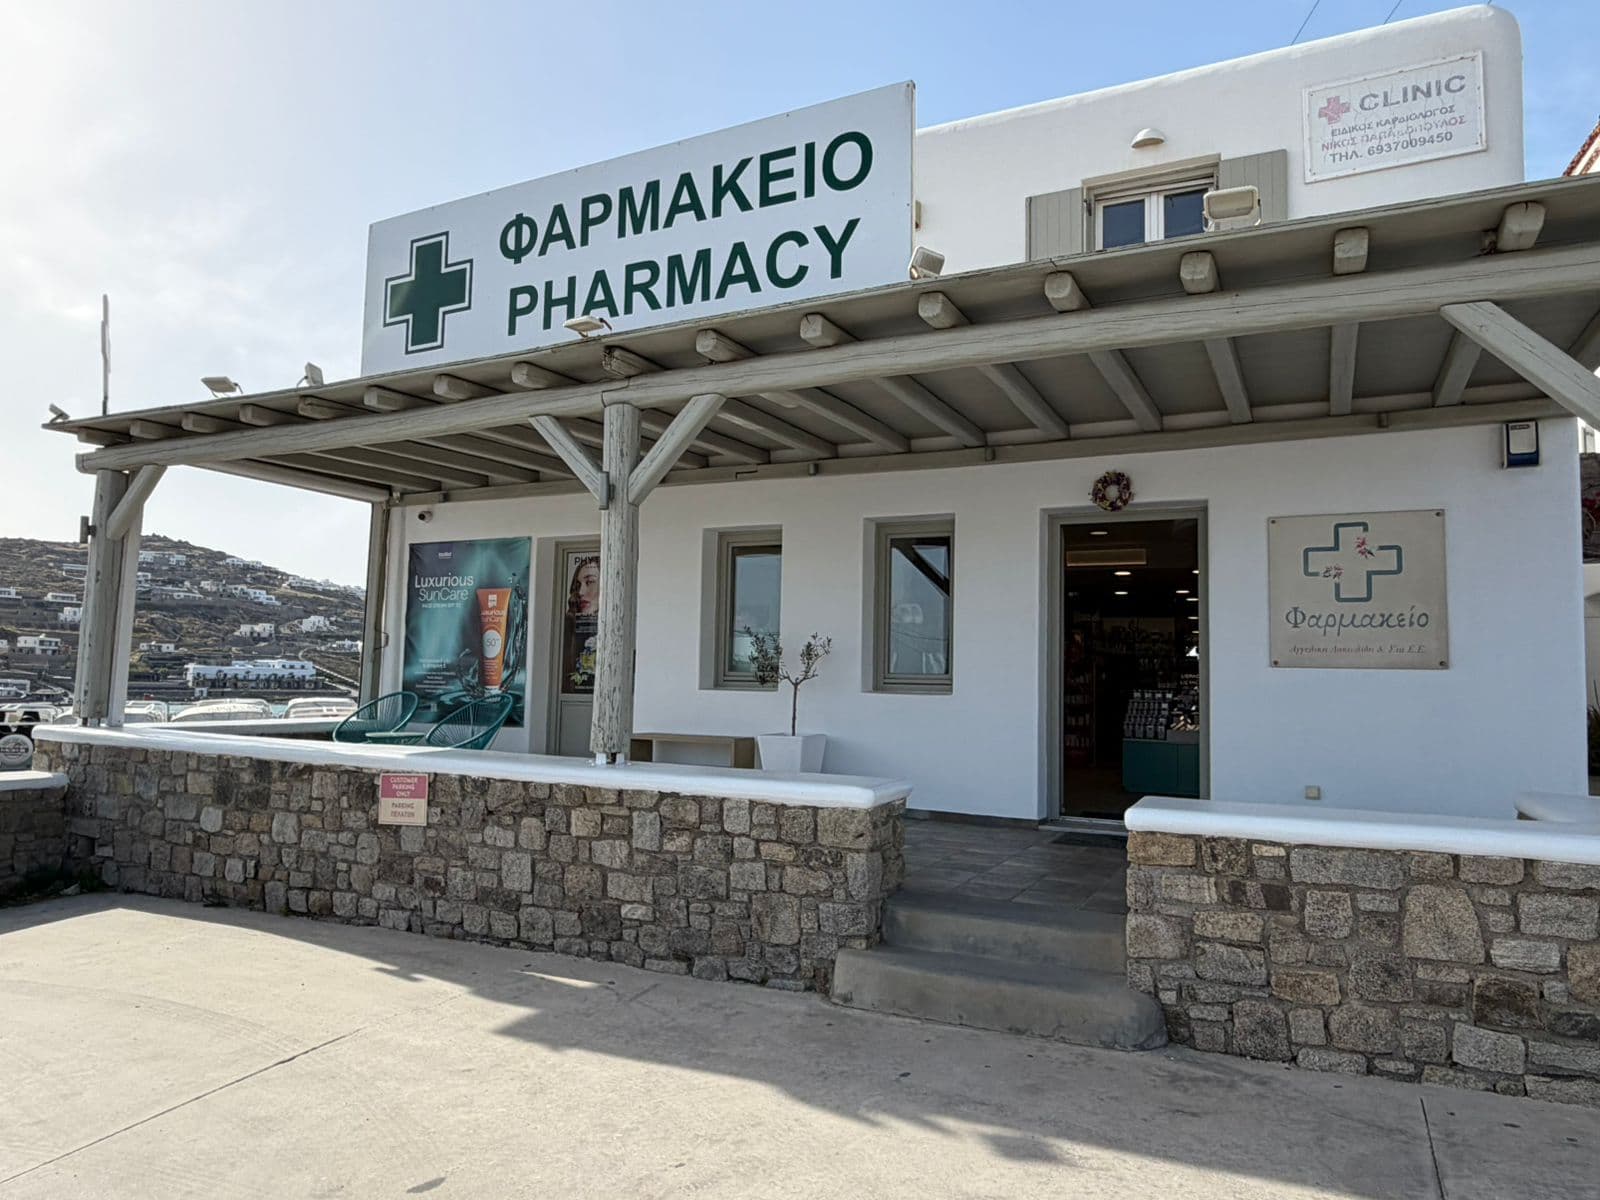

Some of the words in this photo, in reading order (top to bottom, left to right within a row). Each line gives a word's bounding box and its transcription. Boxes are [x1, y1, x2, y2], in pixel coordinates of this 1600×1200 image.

[1358, 74, 1467, 112] CLINIC
[1330, 122, 1374, 138] ΕΙΔΙΚΟΣ
[1376, 104, 1456, 129] ΚΑΡΔΙΟΛΟΓΟΣ
[1321, 136, 1359, 152] ΝΙΚΟΣ
[1329, 150, 1363, 164] ΤΗΛ.
[1367, 130, 1454, 156] 6937009450
[499, 130, 874, 265] ΦΑΡΜΑΚΕΙΟ
[507, 217, 861, 336] PHARMACY
[414, 572, 474, 589] Luxurious
[418, 587, 469, 602] SunCare
[1285, 605, 1430, 637] Φαρμακείο
